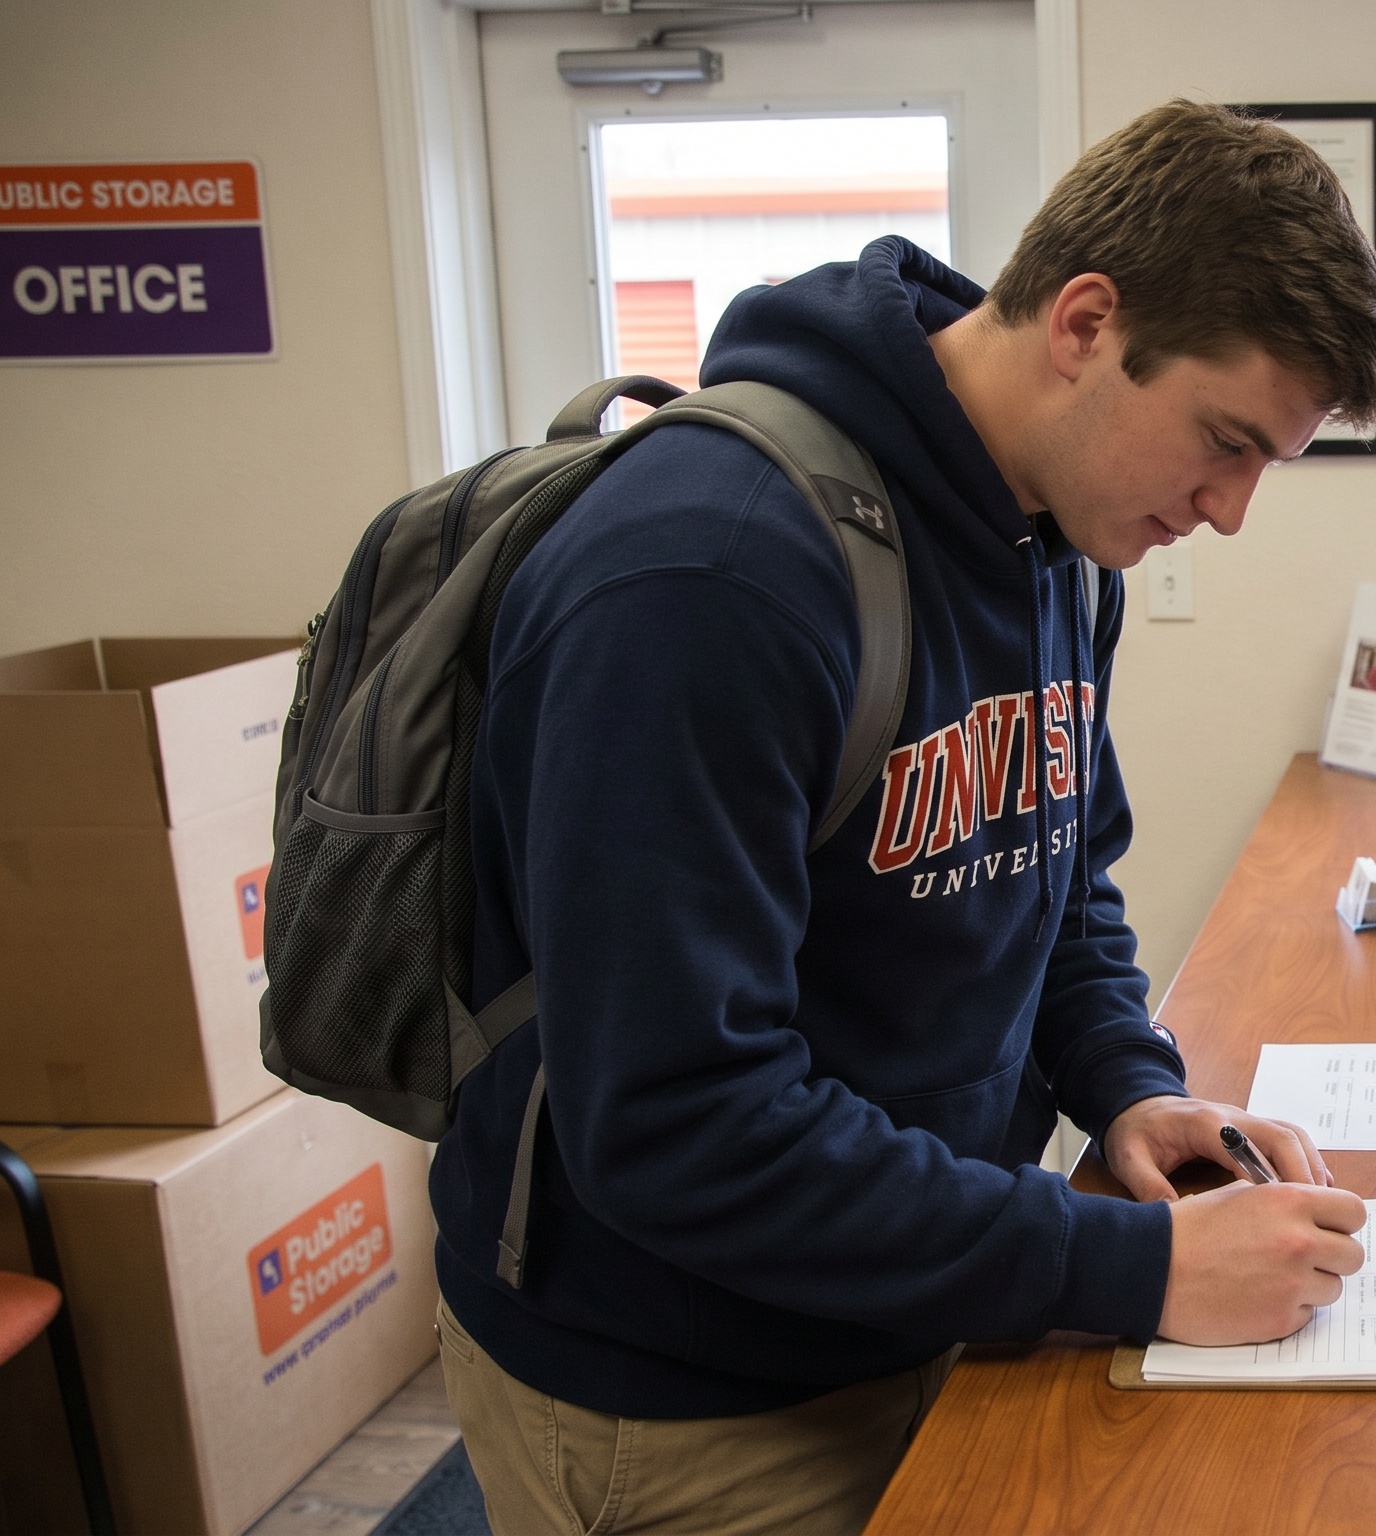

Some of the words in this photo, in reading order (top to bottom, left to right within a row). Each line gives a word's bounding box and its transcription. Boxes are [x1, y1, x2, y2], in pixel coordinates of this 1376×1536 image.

[92, 179, 234, 207] STORAGE
[13, 263, 208, 315] OFFICE
[287, 1200, 363, 1275] Public
